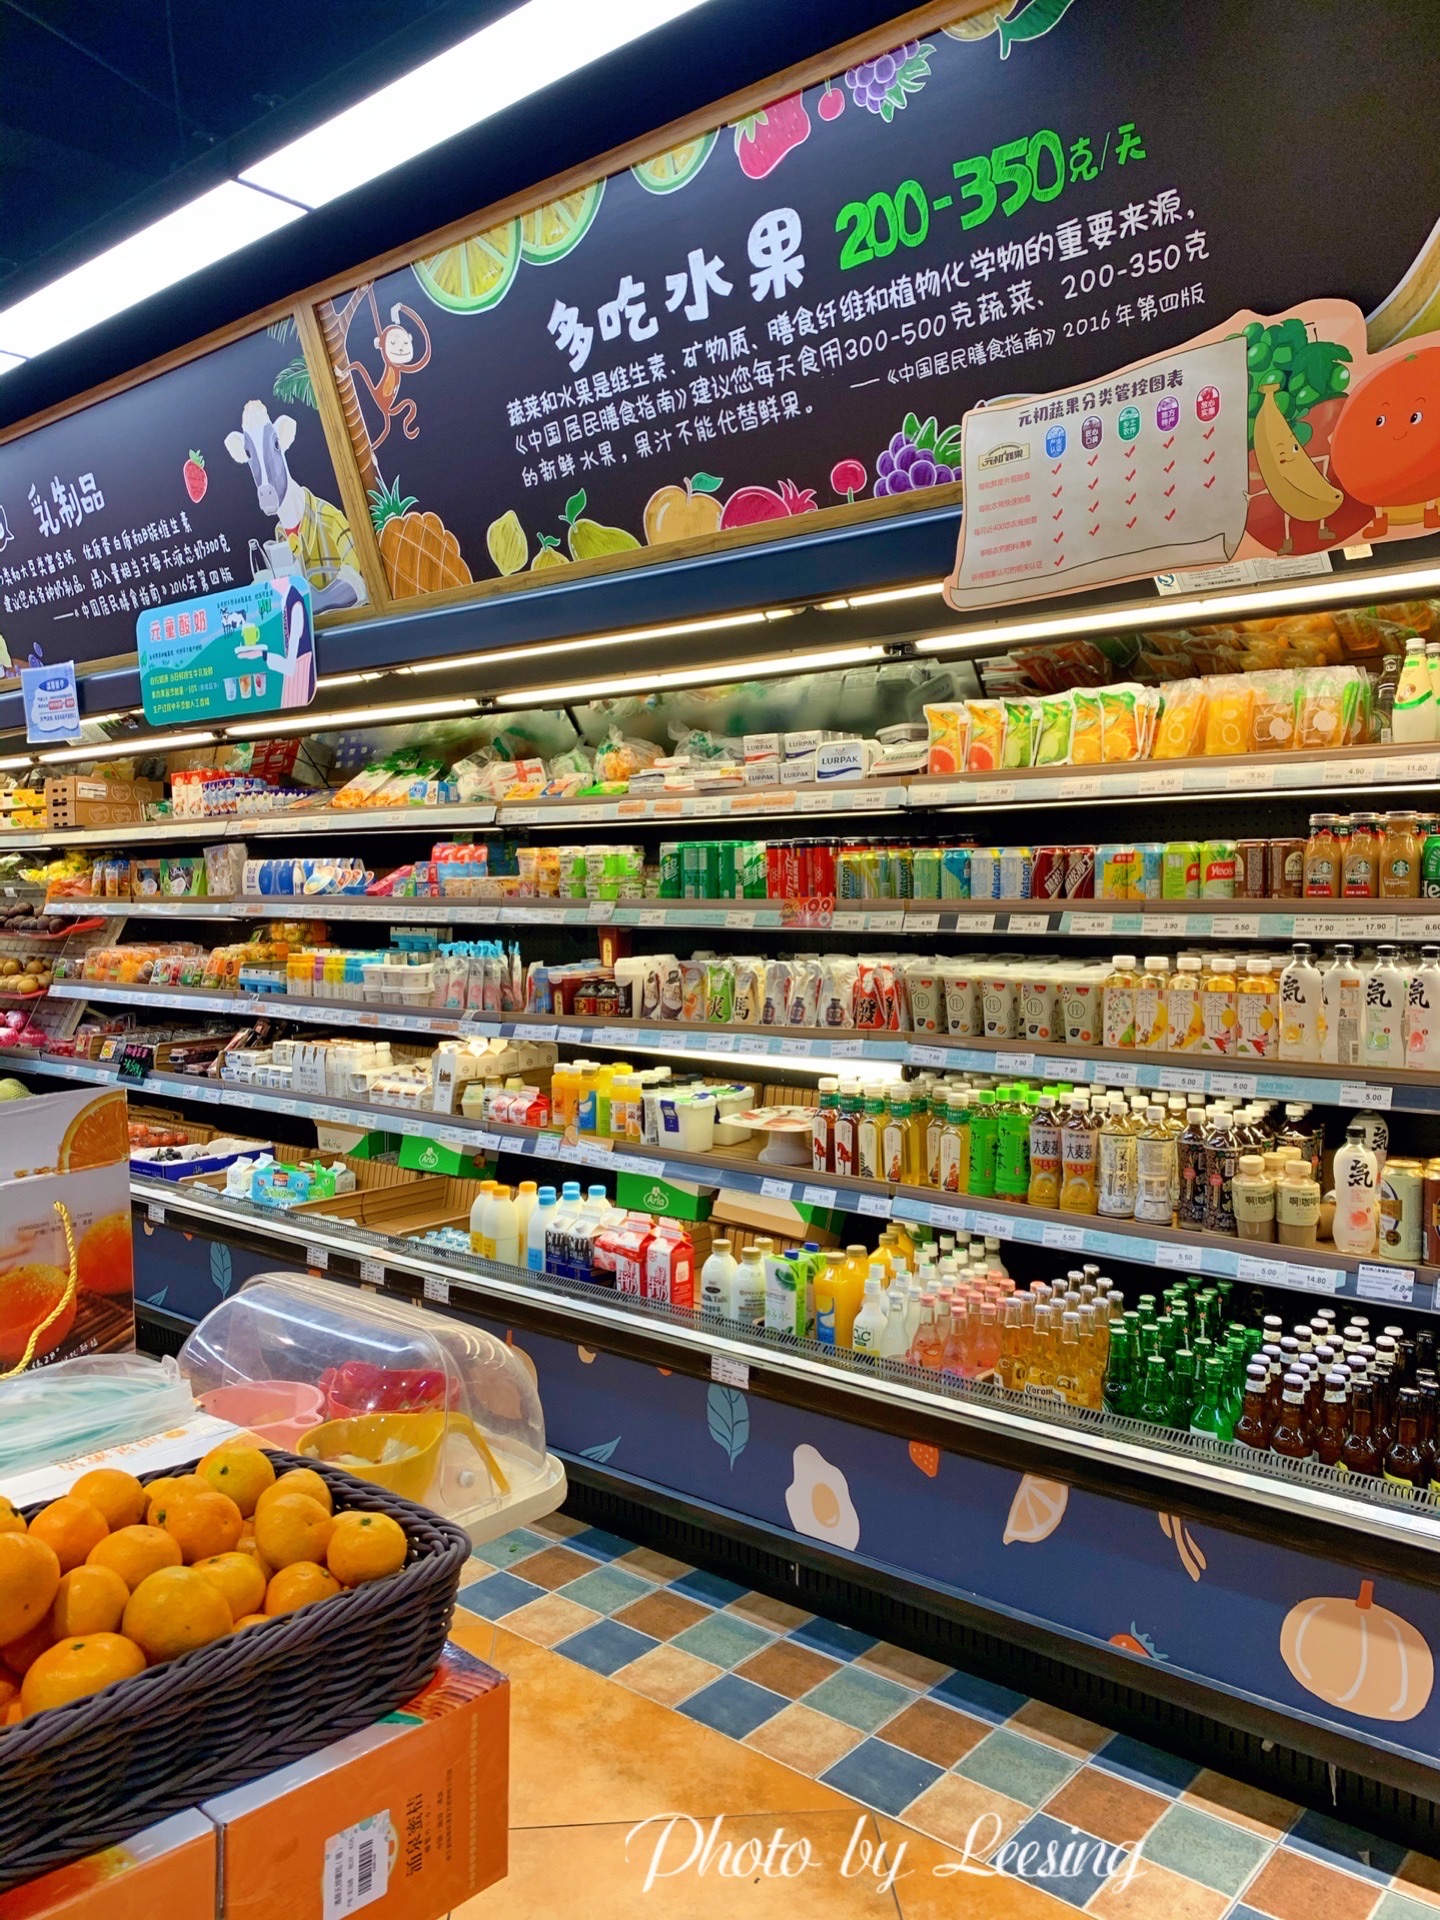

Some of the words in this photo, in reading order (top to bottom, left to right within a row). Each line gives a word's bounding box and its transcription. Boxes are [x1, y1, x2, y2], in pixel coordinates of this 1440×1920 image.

[547, 207, 806, 373] 多吃水果
[1018, 369, 1183, 427] 元初蔬果分类管控图表
[28, 472, 105, 537] 乳制品
[150, 609, 208, 642] 元童酸奶
[747, 743, 774, 751] LURPAK
[788, 739, 817, 748] LURPAK
[822, 755, 859, 765] LURPAK
[748, 773, 775, 781] LURPAK
[784, 771, 810, 779] LURPAK
[900, 856, 908, 899] Watson's
[1020, 855, 1031, 899] Watson's
[1210, 864, 1234, 877] Yeo's
[841, 860, 850, 899] Watson's
[1314, 924, 1335, 932] 17.90
[1366, 923, 1387, 931] 17.90
[1033, 1139, 1059, 1155] 大麦茶
[1066, 1143, 1093, 1159] 大麦茶
[420, 1154, 437, 1166] Arla
[646, 1194, 665, 1207] Arla
[406, 1793, 423, 1878] 涌泉蜜桔
